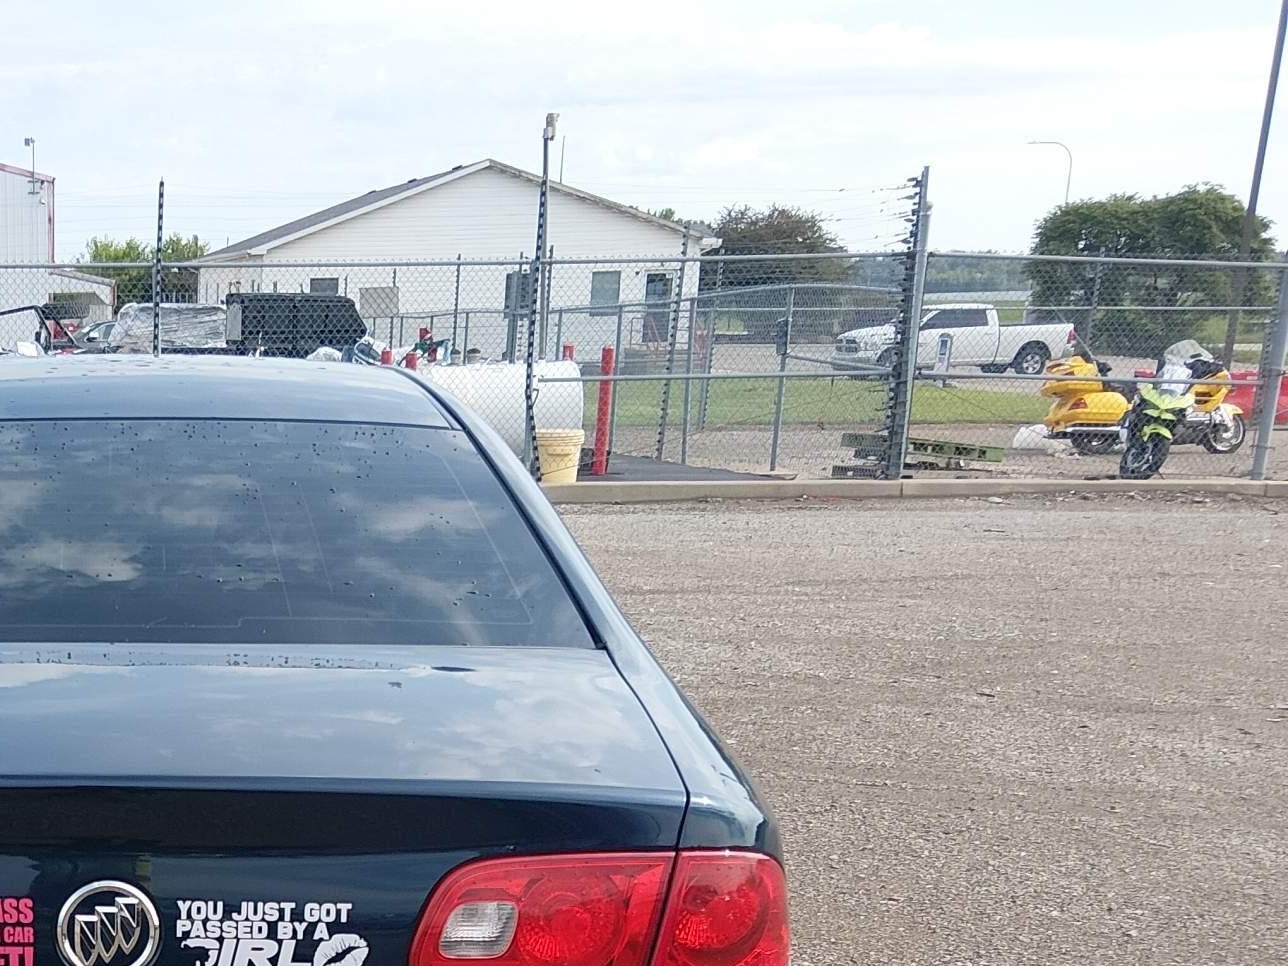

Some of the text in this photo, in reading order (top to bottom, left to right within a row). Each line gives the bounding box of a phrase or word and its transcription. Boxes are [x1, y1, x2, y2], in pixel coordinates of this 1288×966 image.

[176, 900, 353, 923] YOU JUST GOT
[4, 926, 34, 944] CAR
[176, 919, 330, 940] PASSED BY A
